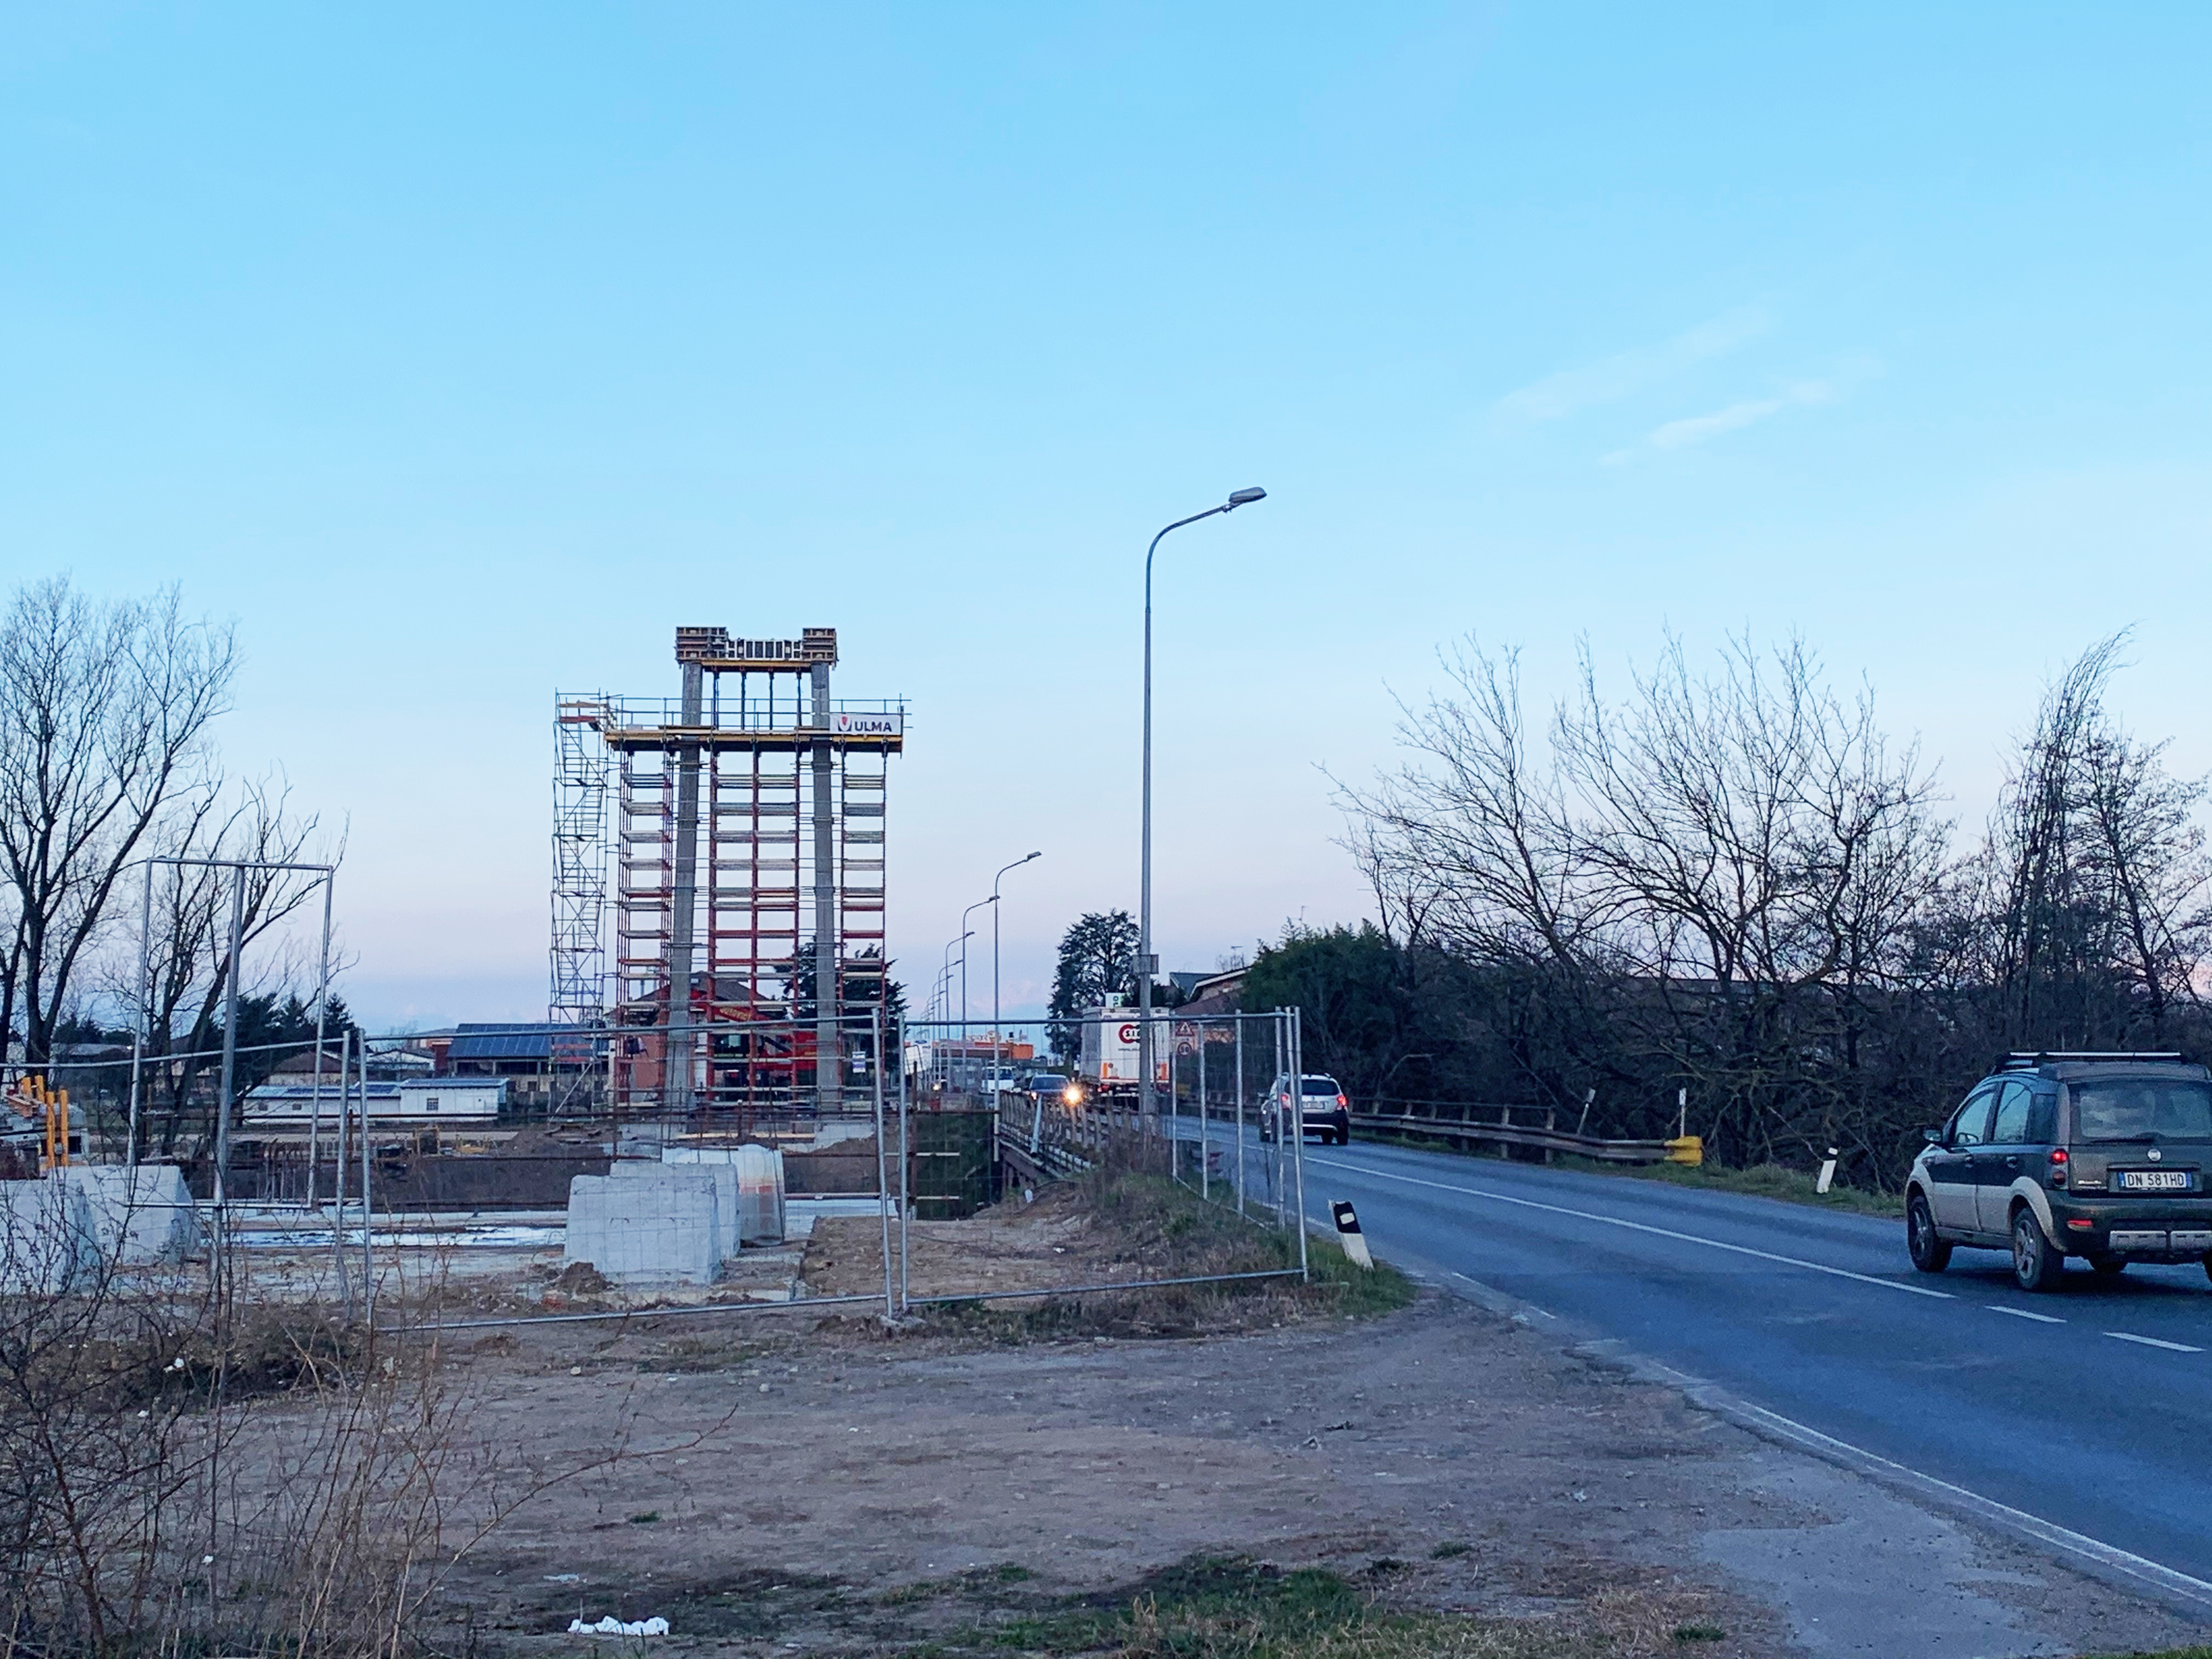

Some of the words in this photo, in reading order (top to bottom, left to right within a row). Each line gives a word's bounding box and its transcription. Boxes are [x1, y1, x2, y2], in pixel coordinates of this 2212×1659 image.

[855, 721, 892, 732] ULMA
[2128, 1174, 2142, 1186] DN
[2148, 1174, 2184, 1186] 581HD
